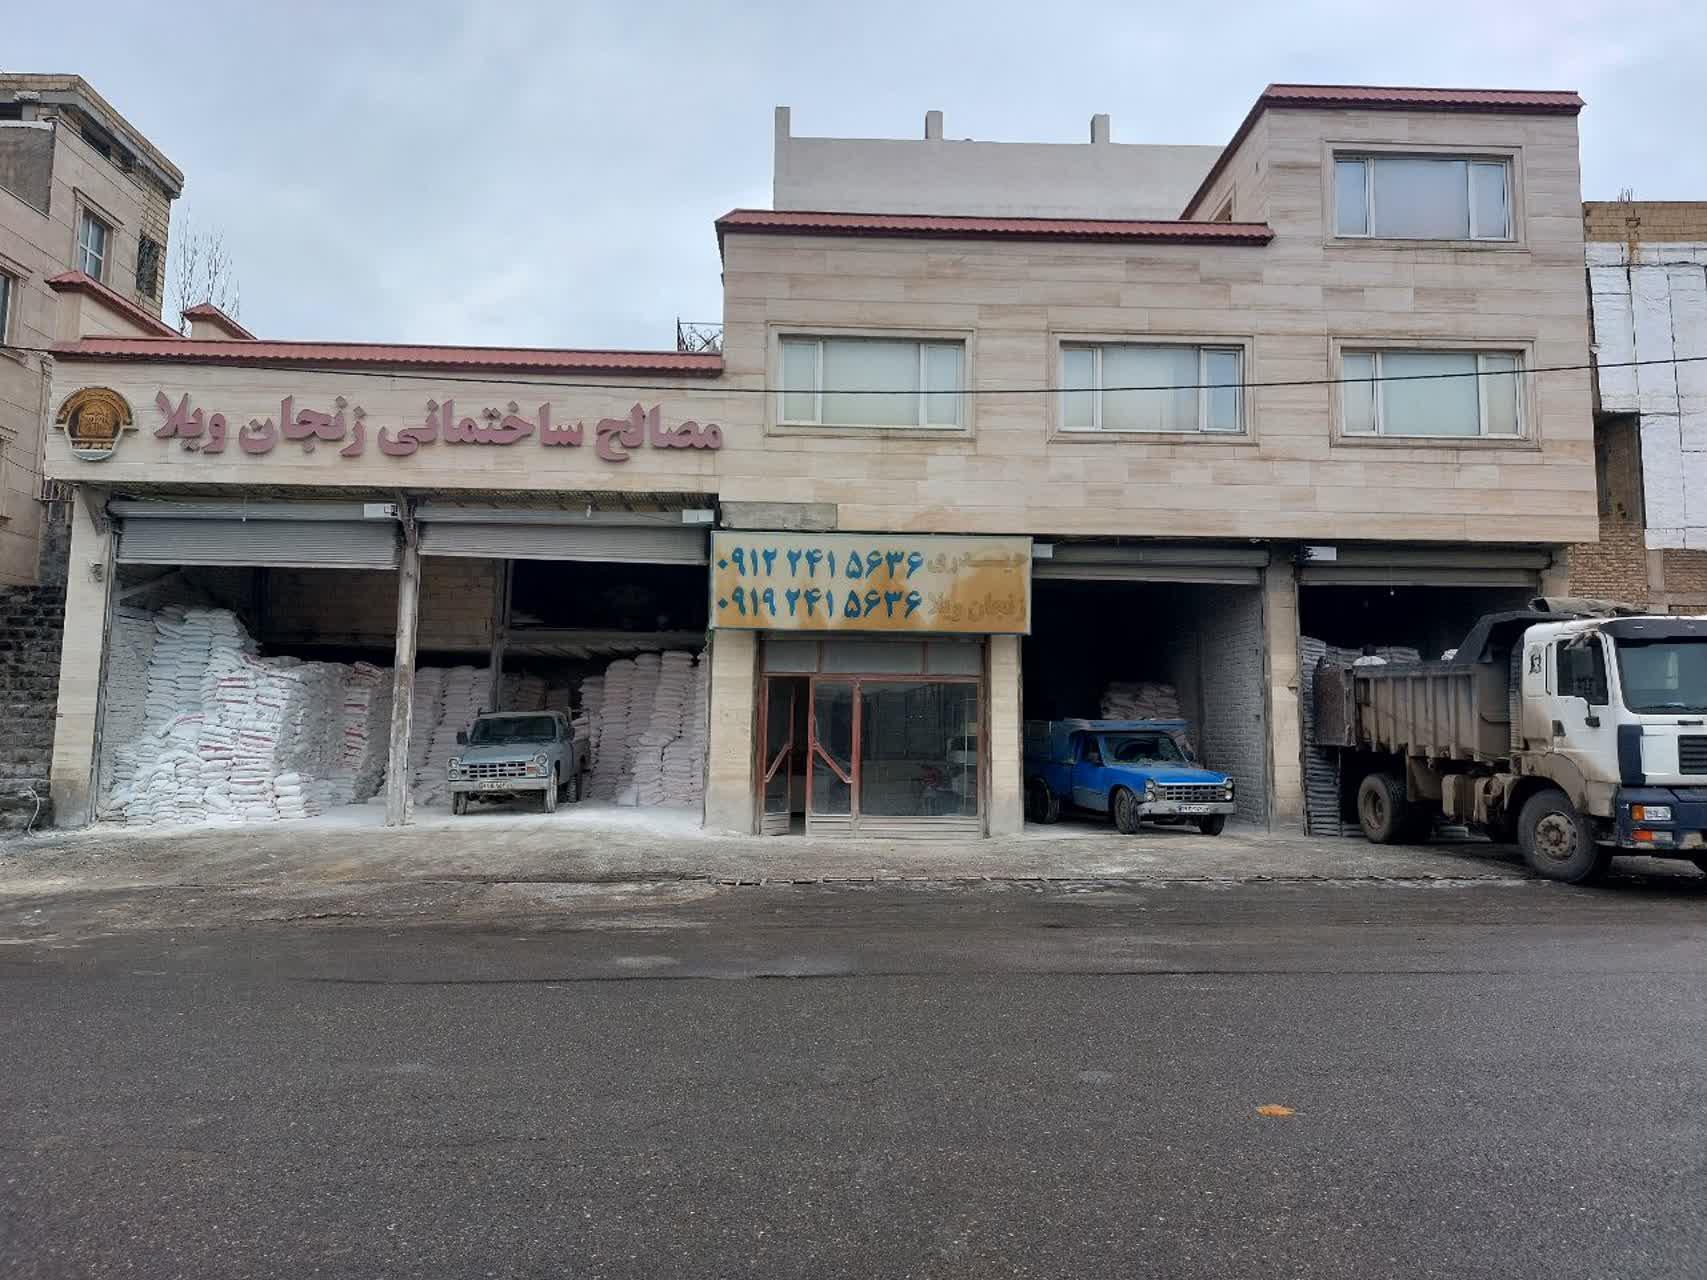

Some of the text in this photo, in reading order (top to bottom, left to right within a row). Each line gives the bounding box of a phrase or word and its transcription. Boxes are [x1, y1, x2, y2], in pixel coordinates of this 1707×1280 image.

[153, 390, 227, 455] ویلا
[239, 395, 367, 457] زنجان
[377, 399, 584, 457] ساختمانی
[596, 402, 722, 462] مصالح
